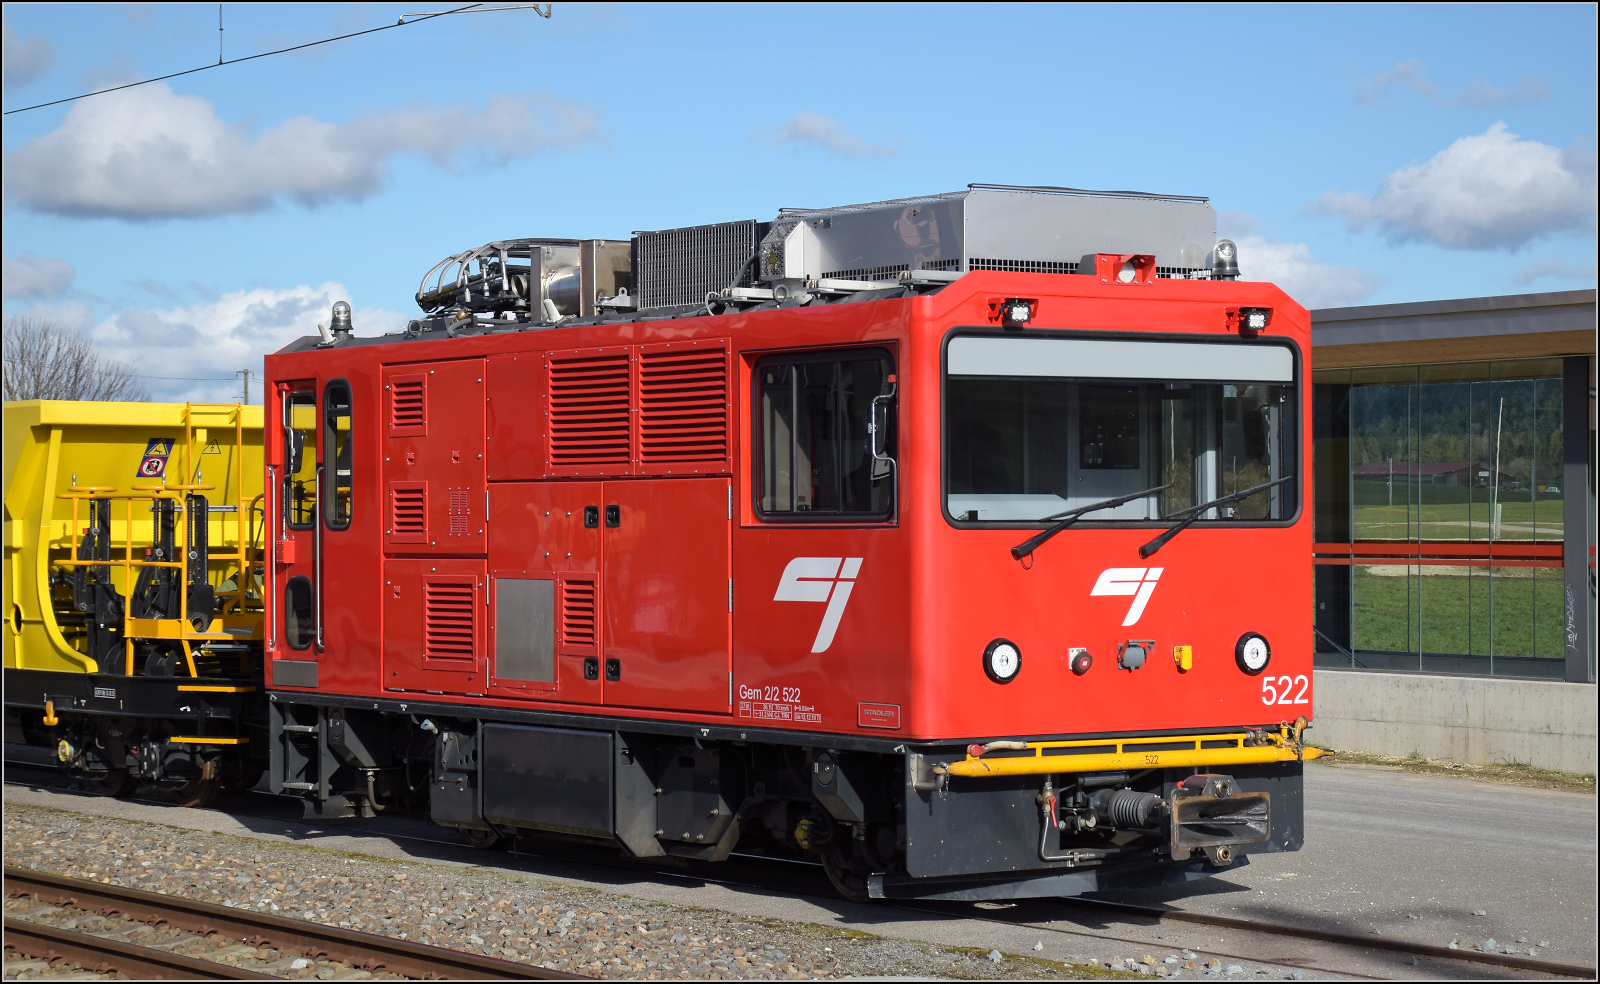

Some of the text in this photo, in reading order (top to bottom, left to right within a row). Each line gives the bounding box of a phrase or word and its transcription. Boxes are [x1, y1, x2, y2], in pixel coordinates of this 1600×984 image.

[739, 684, 801, 703] Gem 2/2 522
[1261, 674, 1309, 706] 522
[864, 709, 895, 717] STADLER
[1145, 754, 1159, 765] 522
